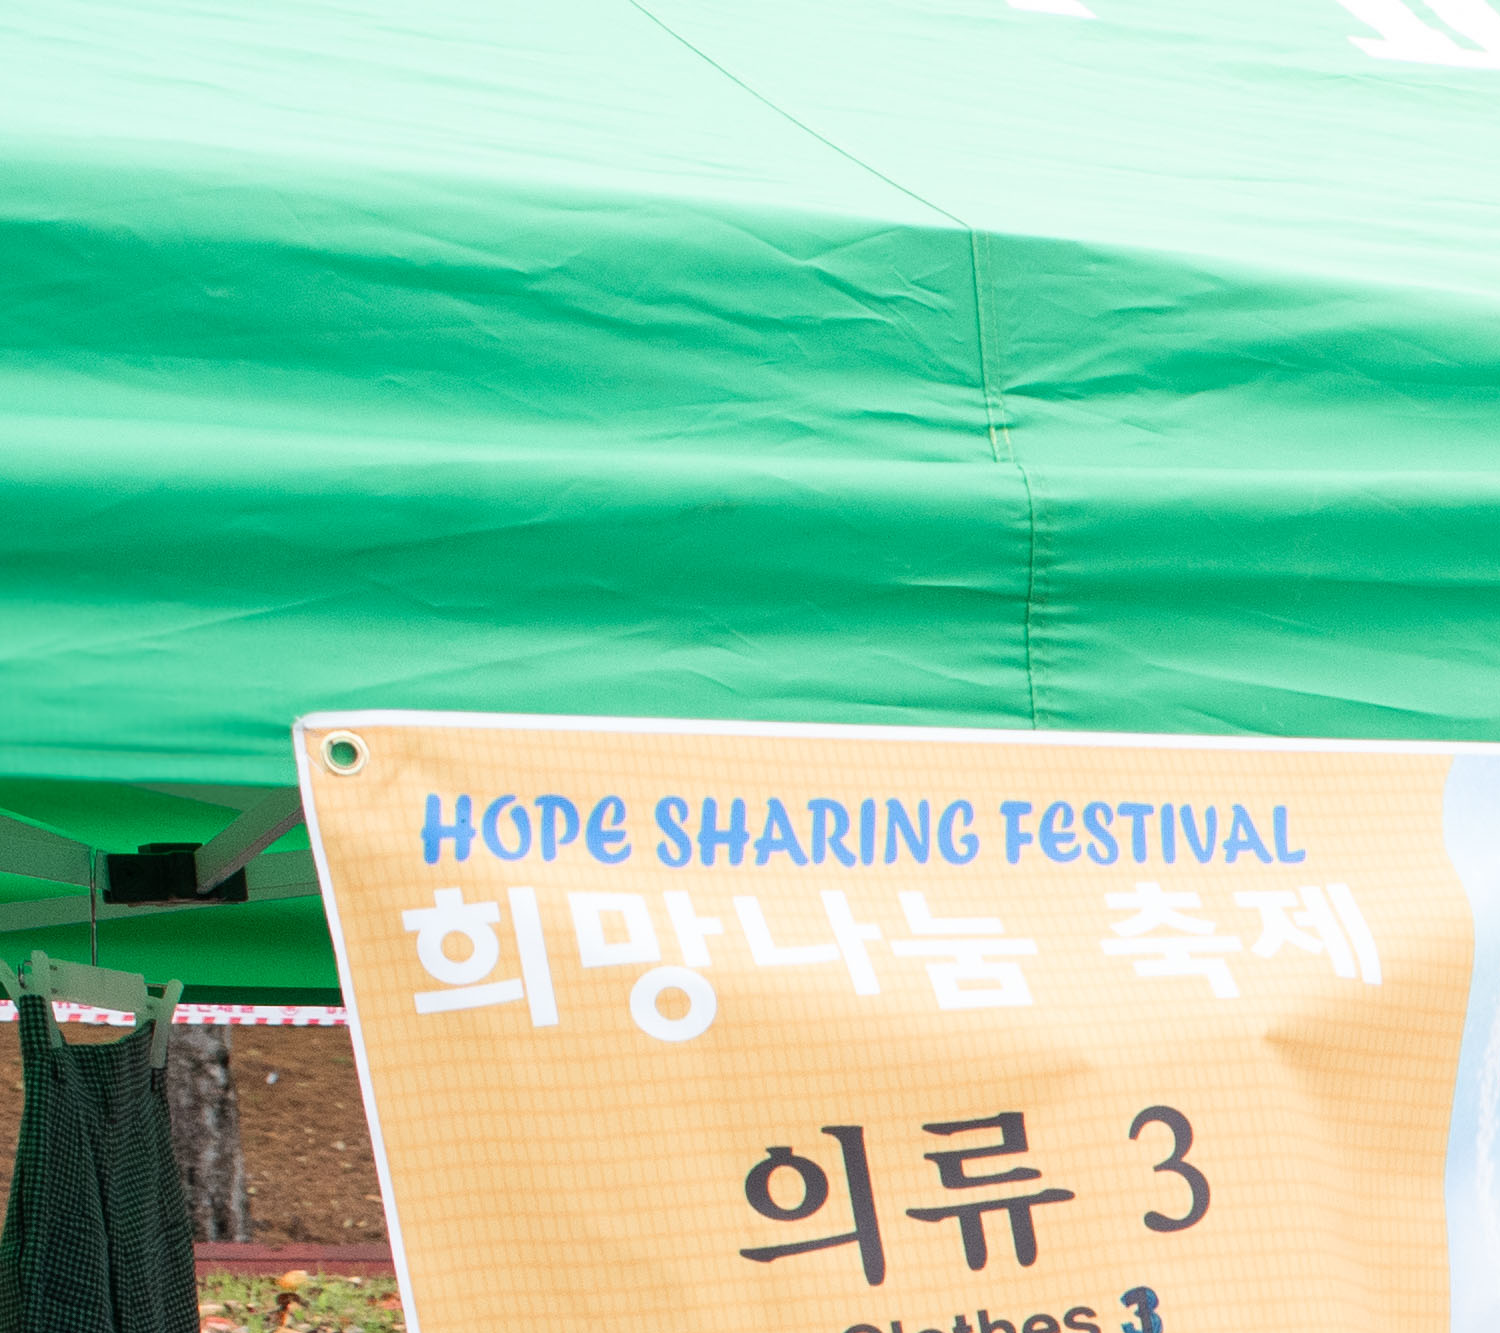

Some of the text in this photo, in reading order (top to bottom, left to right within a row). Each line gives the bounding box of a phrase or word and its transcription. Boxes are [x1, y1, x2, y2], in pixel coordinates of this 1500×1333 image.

[421, 794, 1307, 867] HOPE SHARING FESTIVAL
[402, 880, 1383, 1042] 희망나눔 축제
[740, 1106, 1210, 1285] 의류 3
